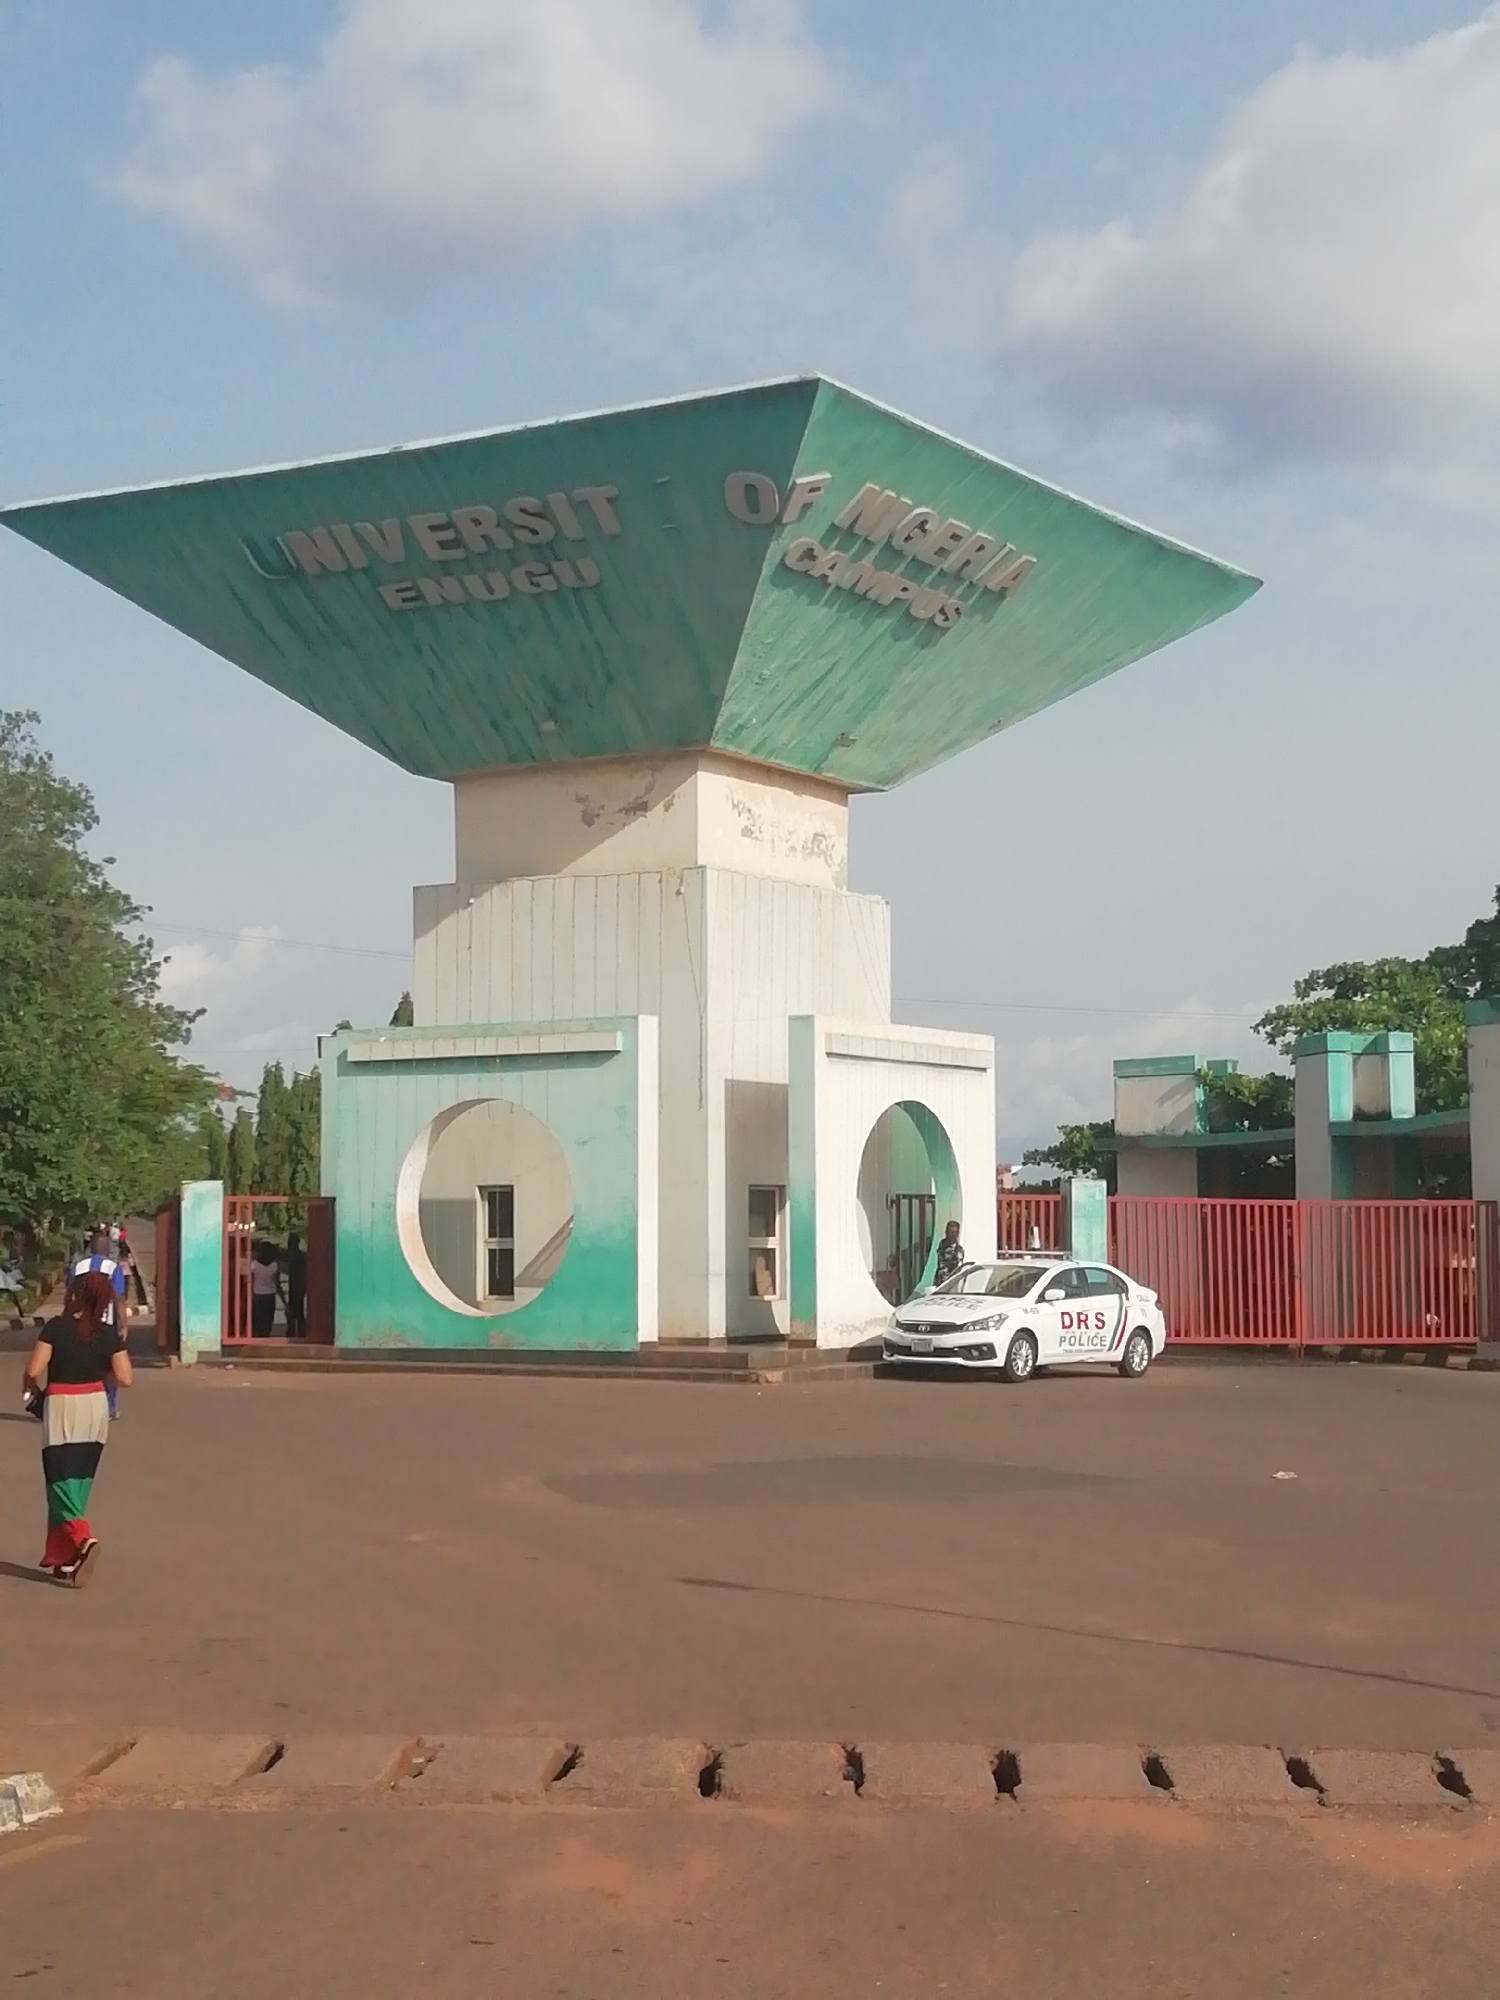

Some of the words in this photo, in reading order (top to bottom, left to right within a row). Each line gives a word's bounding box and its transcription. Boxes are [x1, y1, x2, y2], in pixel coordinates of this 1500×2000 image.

[724, 471, 832, 525] OF
[834, 482, 1038, 593] NIGERIA
[378, 556, 601, 611] ENUGU
[783, 537, 965, 628] CAMPUS
[1058, 1335, 1107, 1347] POLICE
[1060, 1311, 1106, 1330] DRS
